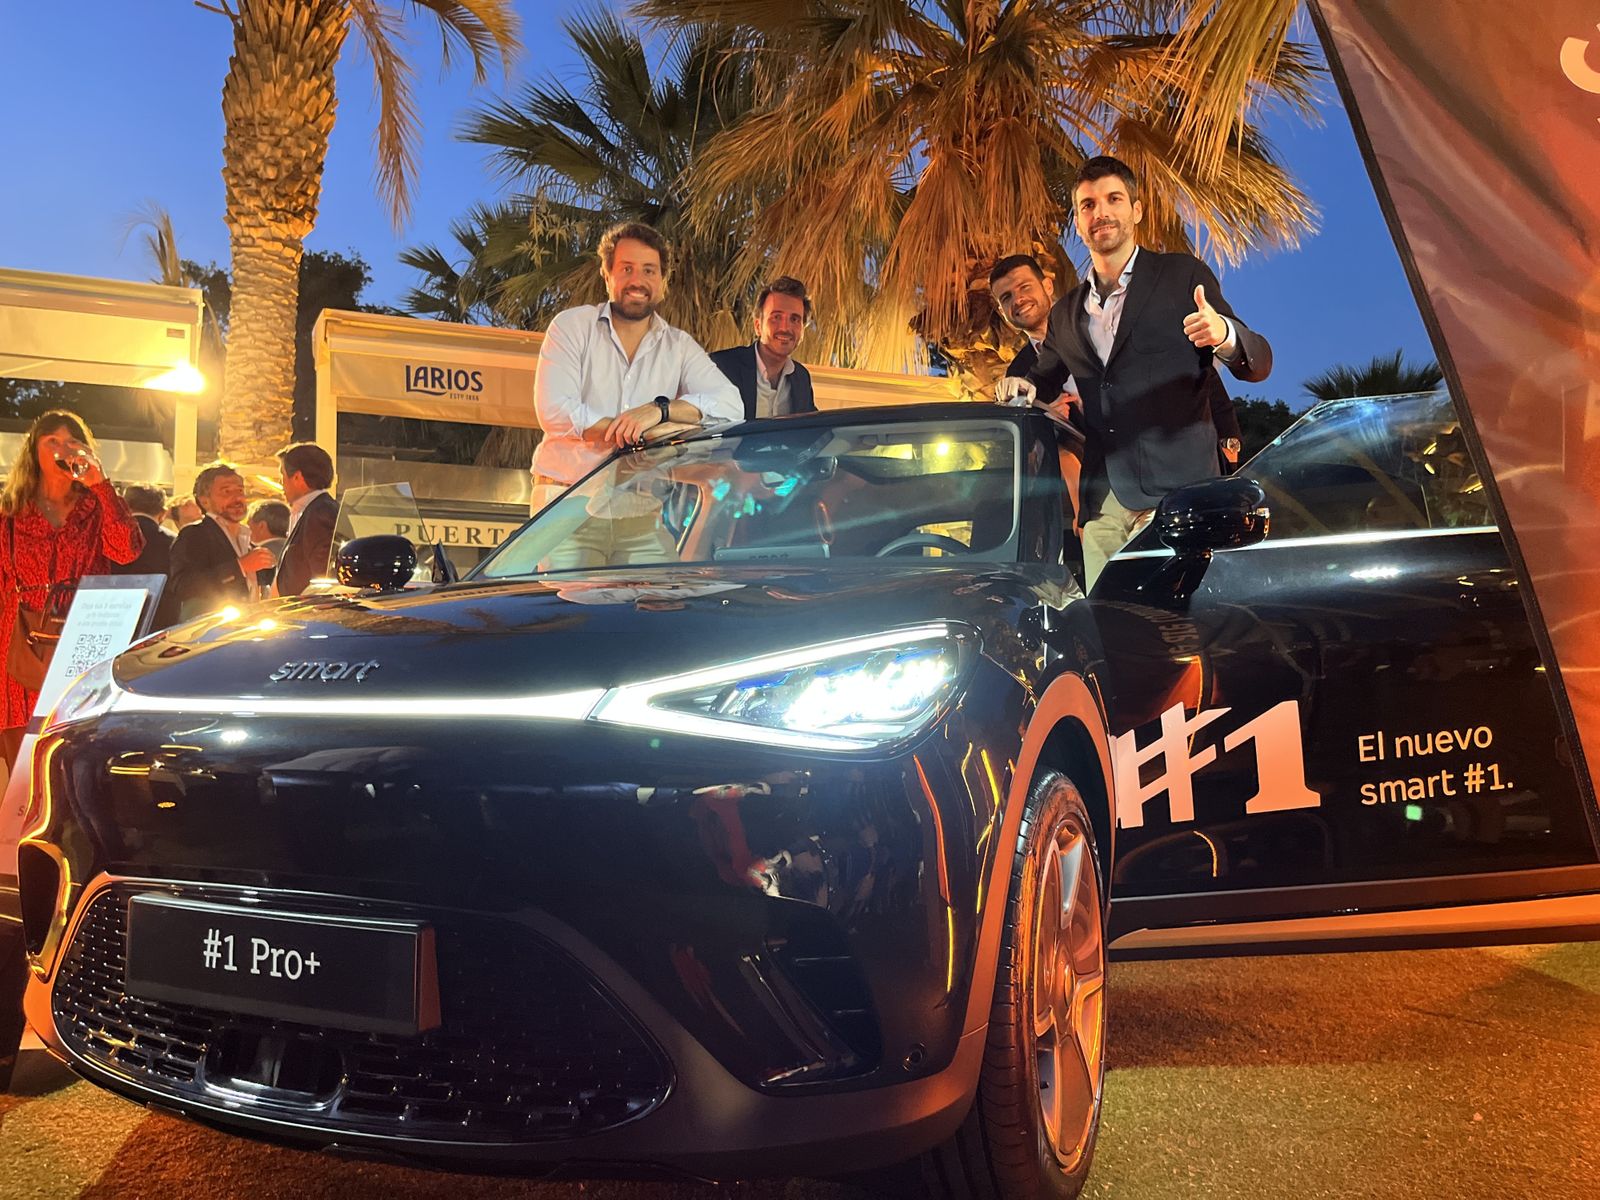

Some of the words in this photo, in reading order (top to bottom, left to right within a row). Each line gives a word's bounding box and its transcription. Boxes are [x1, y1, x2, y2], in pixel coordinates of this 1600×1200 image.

[405, 364, 483, 396] LARIOS
[394, 522, 517, 545] PUERT
[269, 659, 380, 683] smart
[1357, 732, 1385, 763] El
[1394, 725, 1494, 758] nuevo
[1116, 700, 1321, 829] #1
[1360, 770, 1457, 806] smart
[1463, 763, 1515, 794] #1.
[203, 928, 238, 971] #1
[250, 936, 321, 981] Pro+
